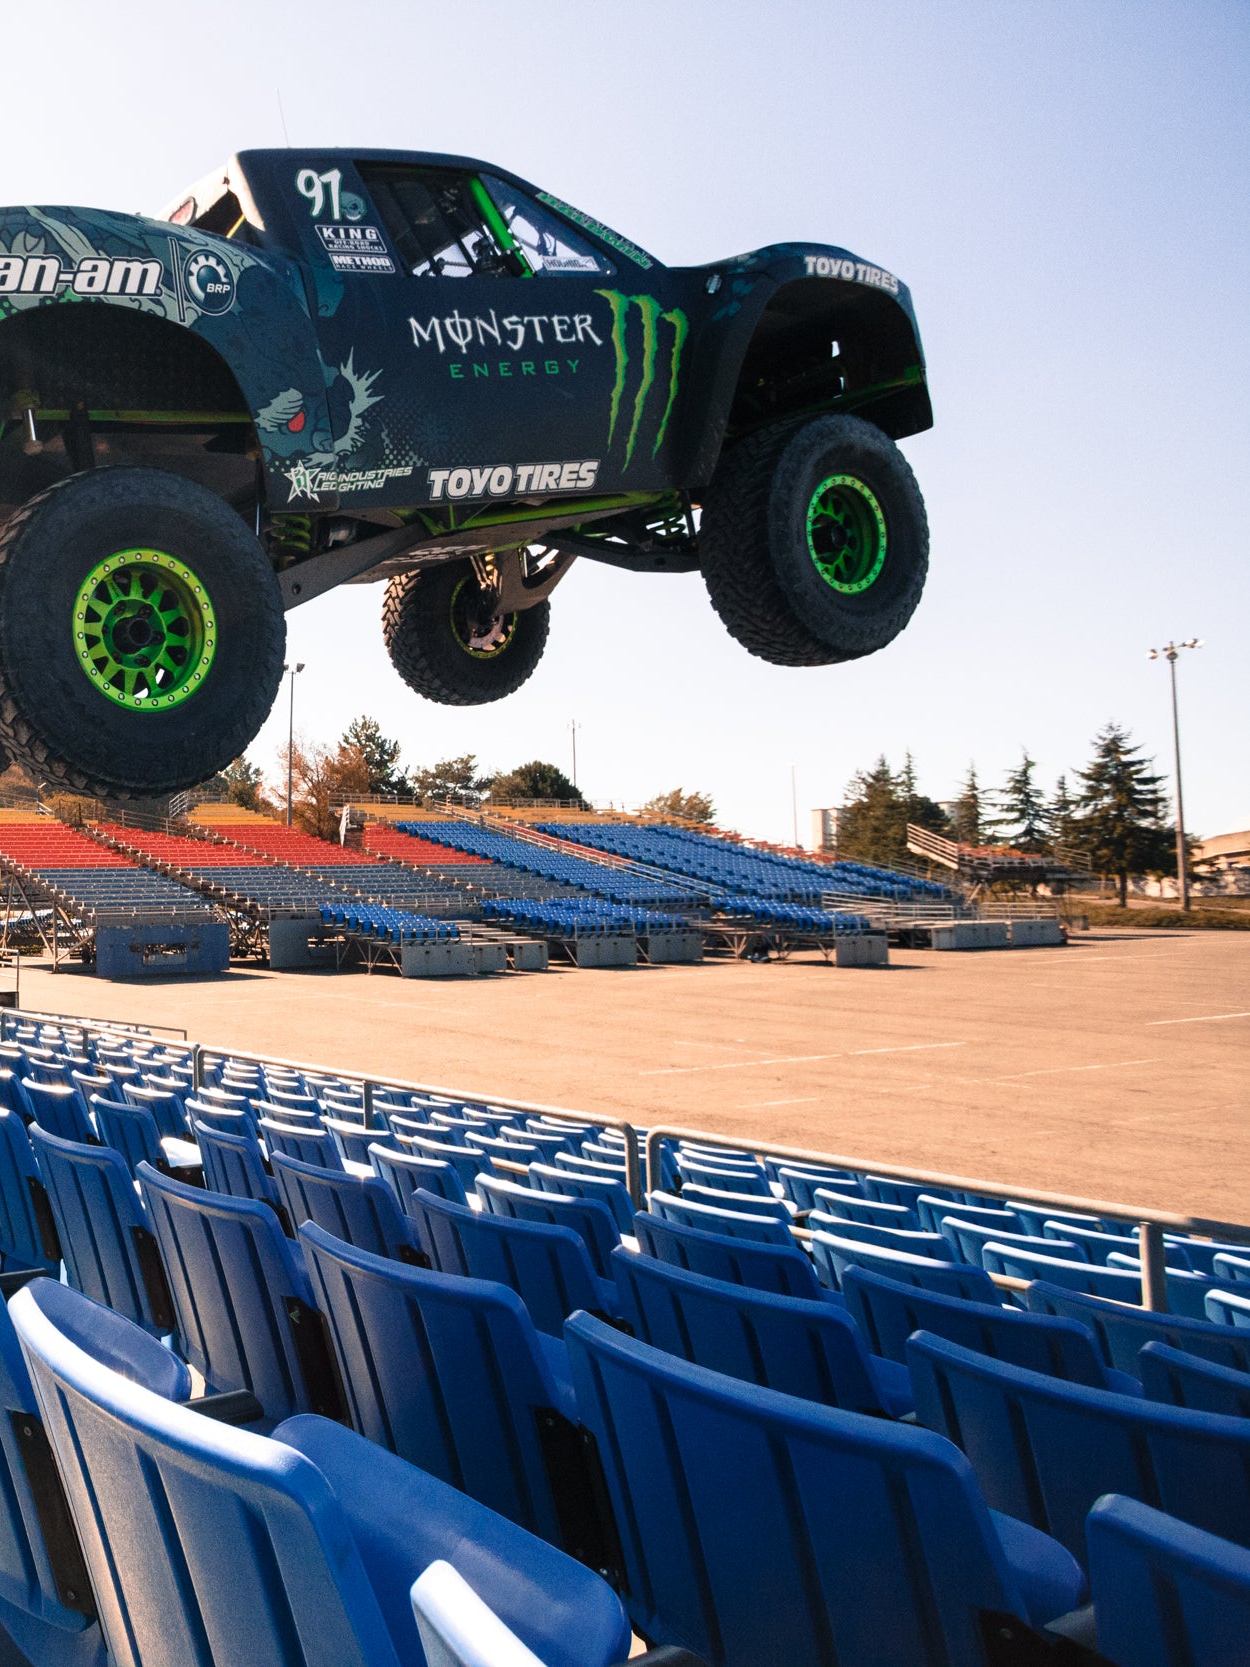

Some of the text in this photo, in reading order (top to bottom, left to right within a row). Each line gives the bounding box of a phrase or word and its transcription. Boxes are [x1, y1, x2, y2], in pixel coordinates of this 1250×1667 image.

[322, 228, 377, 239] KING
[332, 255, 391, 267] METHOD
[804, 256, 899, 295] TOYO TIRES
[206, 283, 231, 294] BRP
[407, 308, 604, 354] MONSTER
[450, 359, 580, 379] ENERGY
[338, 466, 413, 482] INDUSTRIES
[429, 461, 599, 498] TOYO TIRES
